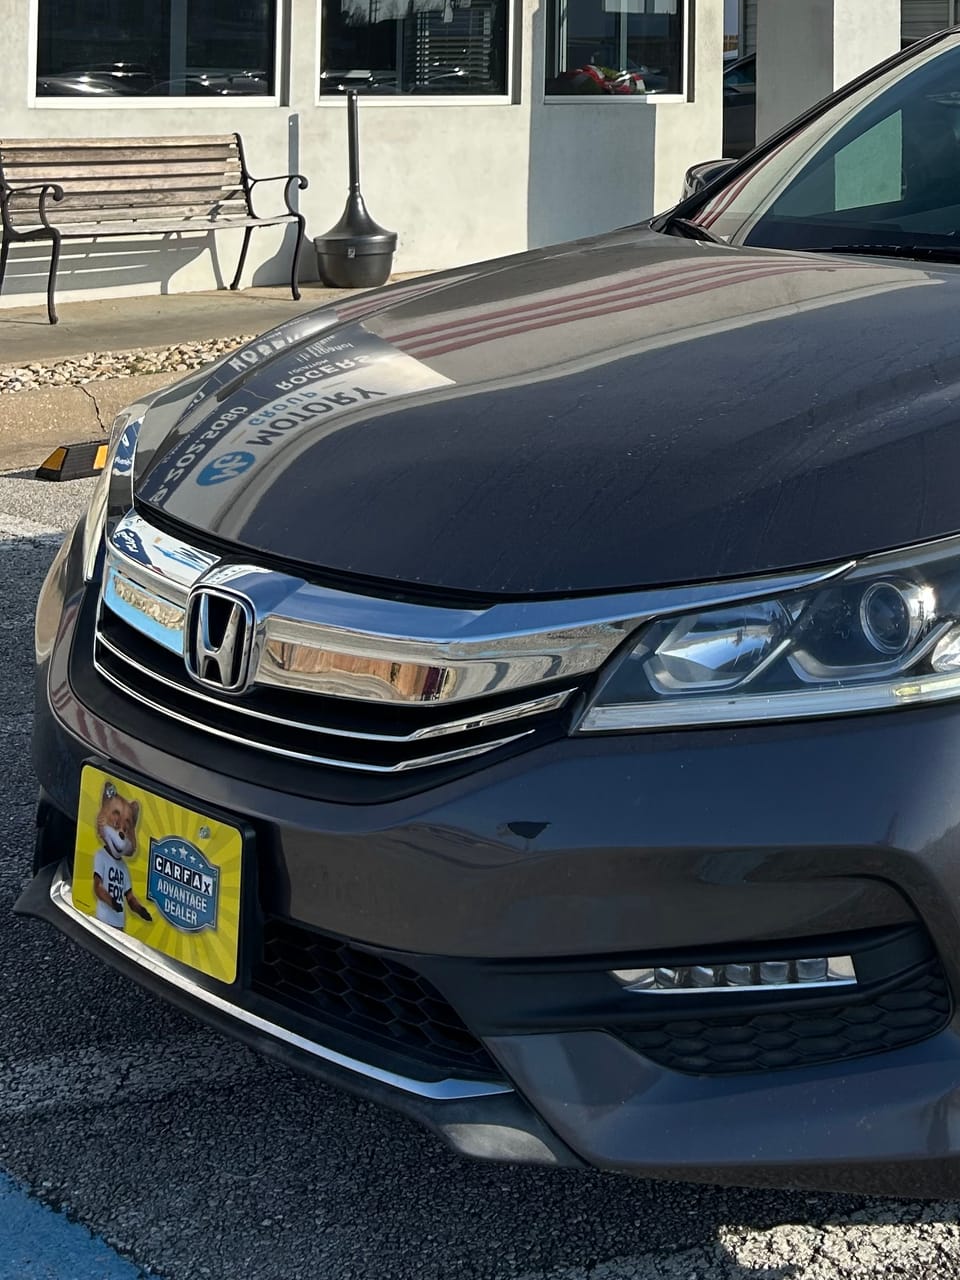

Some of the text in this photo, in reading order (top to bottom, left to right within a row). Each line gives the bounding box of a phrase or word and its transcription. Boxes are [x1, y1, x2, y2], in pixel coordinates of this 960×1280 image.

[108, 867, 124, 885] CAR
[155, 857, 211, 895] CARFAX
[108, 883, 124, 901] FOX
[157, 879, 207, 913] ADVANTAGE
[164, 898, 198, 925] DEALER
